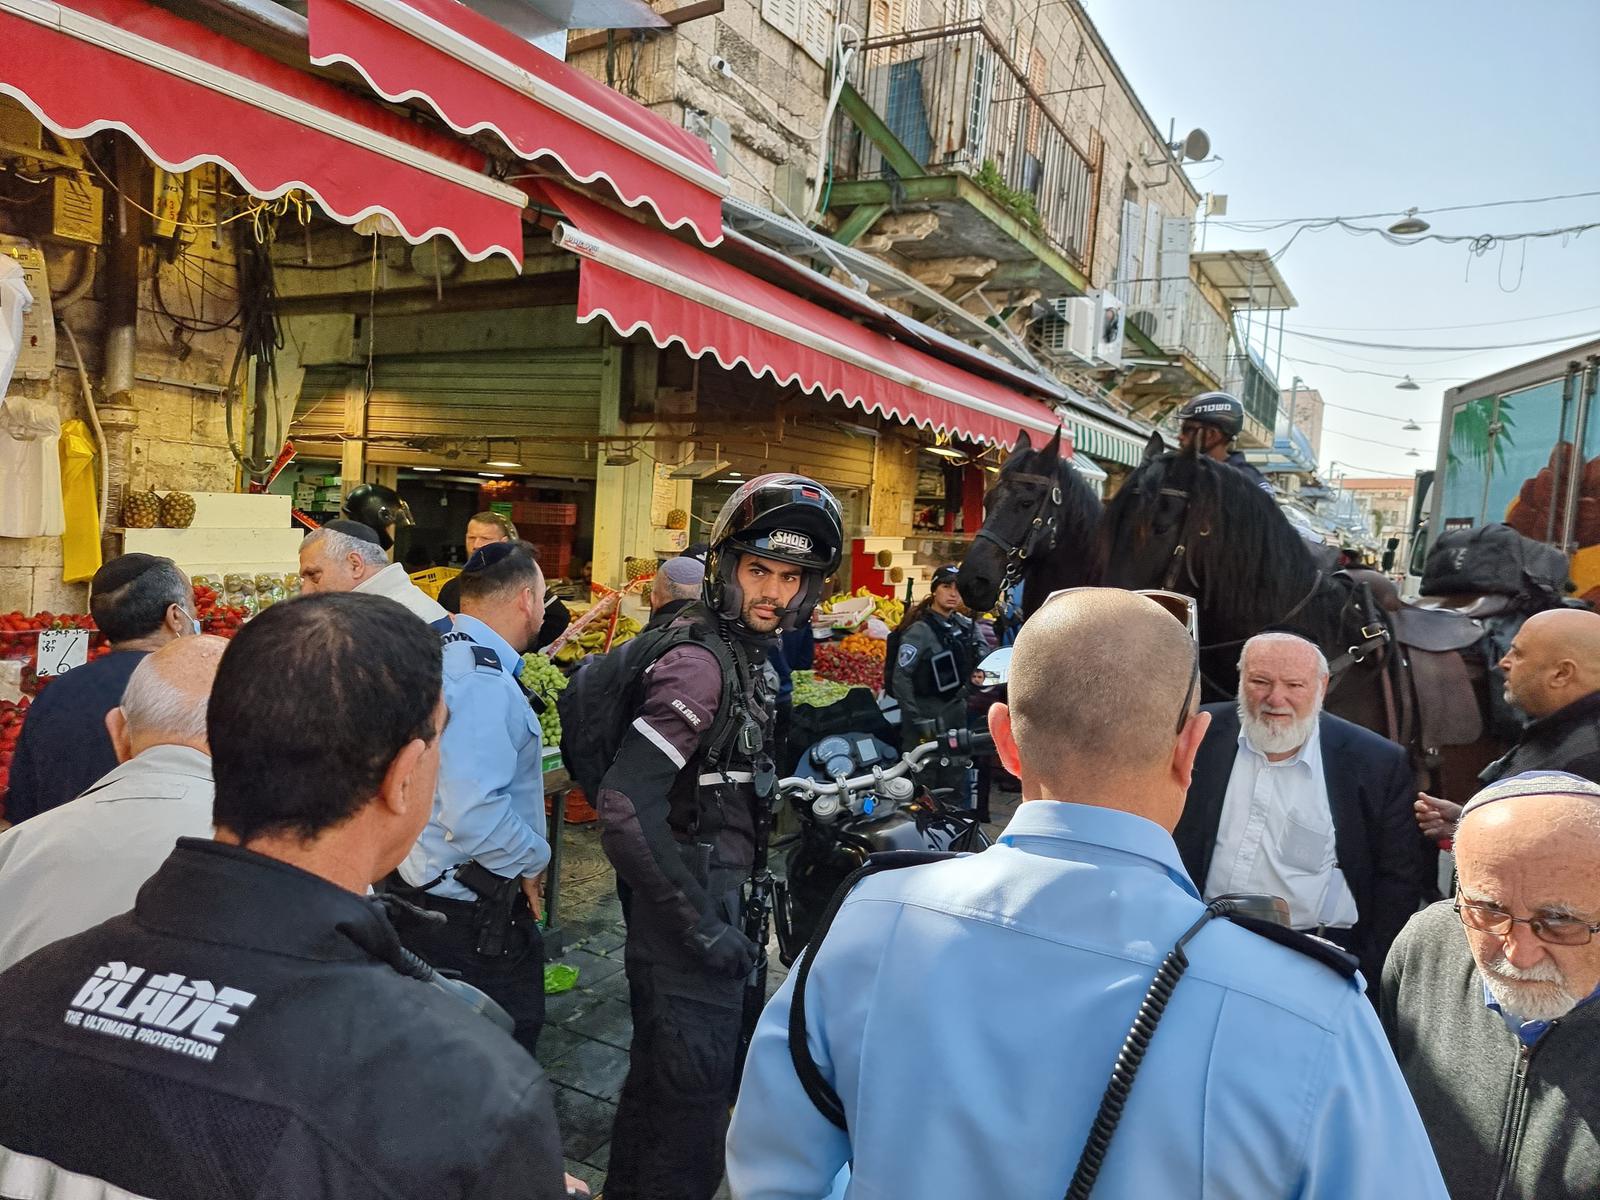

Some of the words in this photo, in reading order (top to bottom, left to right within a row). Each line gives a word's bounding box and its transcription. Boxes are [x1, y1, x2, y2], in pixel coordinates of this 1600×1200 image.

[1194, 404, 1231, 414] משטרה
[774, 531, 808, 549] SHOEI
[672, 699, 701, 726] BLADE
[71, 961, 257, 1042] BLADE
[64, 1009, 85, 1026] THE
[83, 1014, 137, 1039] ULTIMATE
[134, 1028, 218, 1062] PROTECTION
